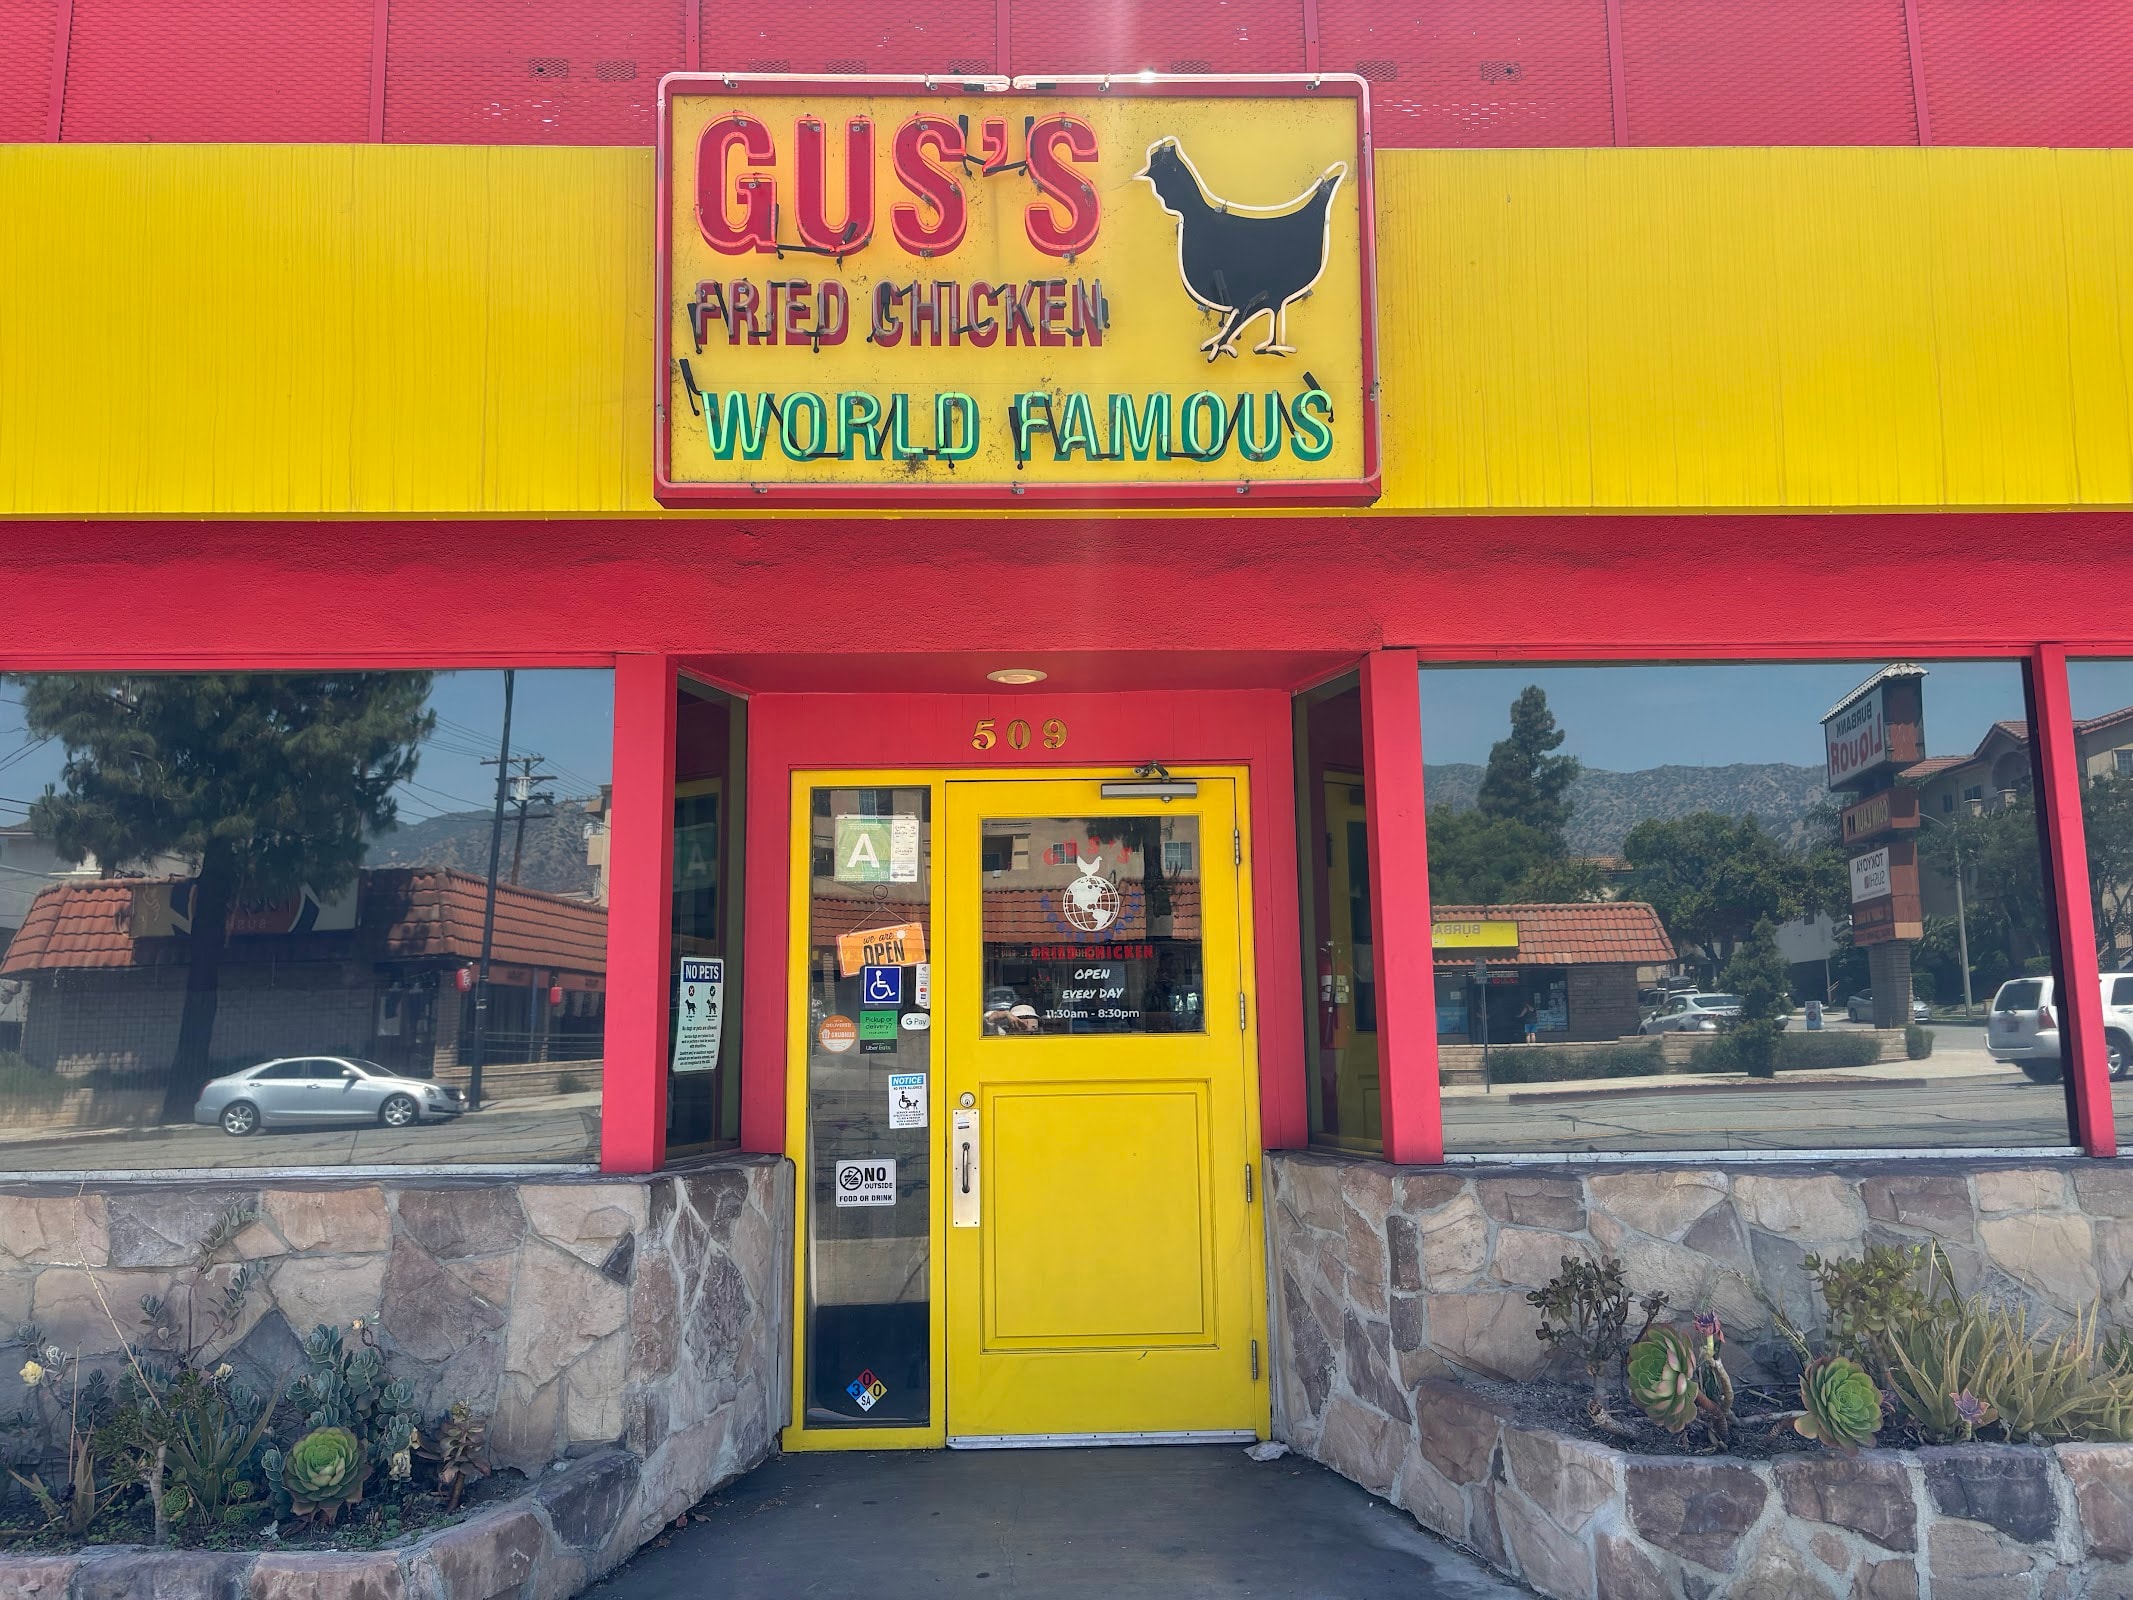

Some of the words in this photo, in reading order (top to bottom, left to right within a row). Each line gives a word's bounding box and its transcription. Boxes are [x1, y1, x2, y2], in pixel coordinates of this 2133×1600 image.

[695, 110, 1101, 257] GUS'S
[695, 280, 849, 347] FRIED
[872, 279, 1104, 348] CHICKEN
[702, 391, 980, 461] WORLD
[1015, 388, 1334, 463] FAMOUS
[971, 718, 1068, 750] 509
[847, 833, 880, 868] A
[863, 936, 876, 945] we
[879, 932, 894, 941] are
[863, 939, 905, 965] OPEN
[1032, 945, 1078, 960] FRIED
[1085, 945, 1154, 960] CHICKEN
[685, 964, 698, 979] NO
[699, 965, 719, 979] PETS
[1074, 968, 1110, 980] OPEN
[1062, 989, 1097, 999] EVERY
[1099, 987, 1124, 998] DAY
[865, 1016, 885, 1024] Pickup
[1045, 1008, 1088, 1019] 11:30am
[1098, 1008, 1140, 1021] 8:30pm
[914, 1017, 927, 1026] Pay
[893, 1077, 923, 1086] NOTICE
[864, 1166, 886, 1182] NO
[863, 1373, 871, 1385] 0
[852, 1384, 860, 1396] 3
[873, 1384, 881, 1396] 0
[862, 1396, 870, 1405] SA
